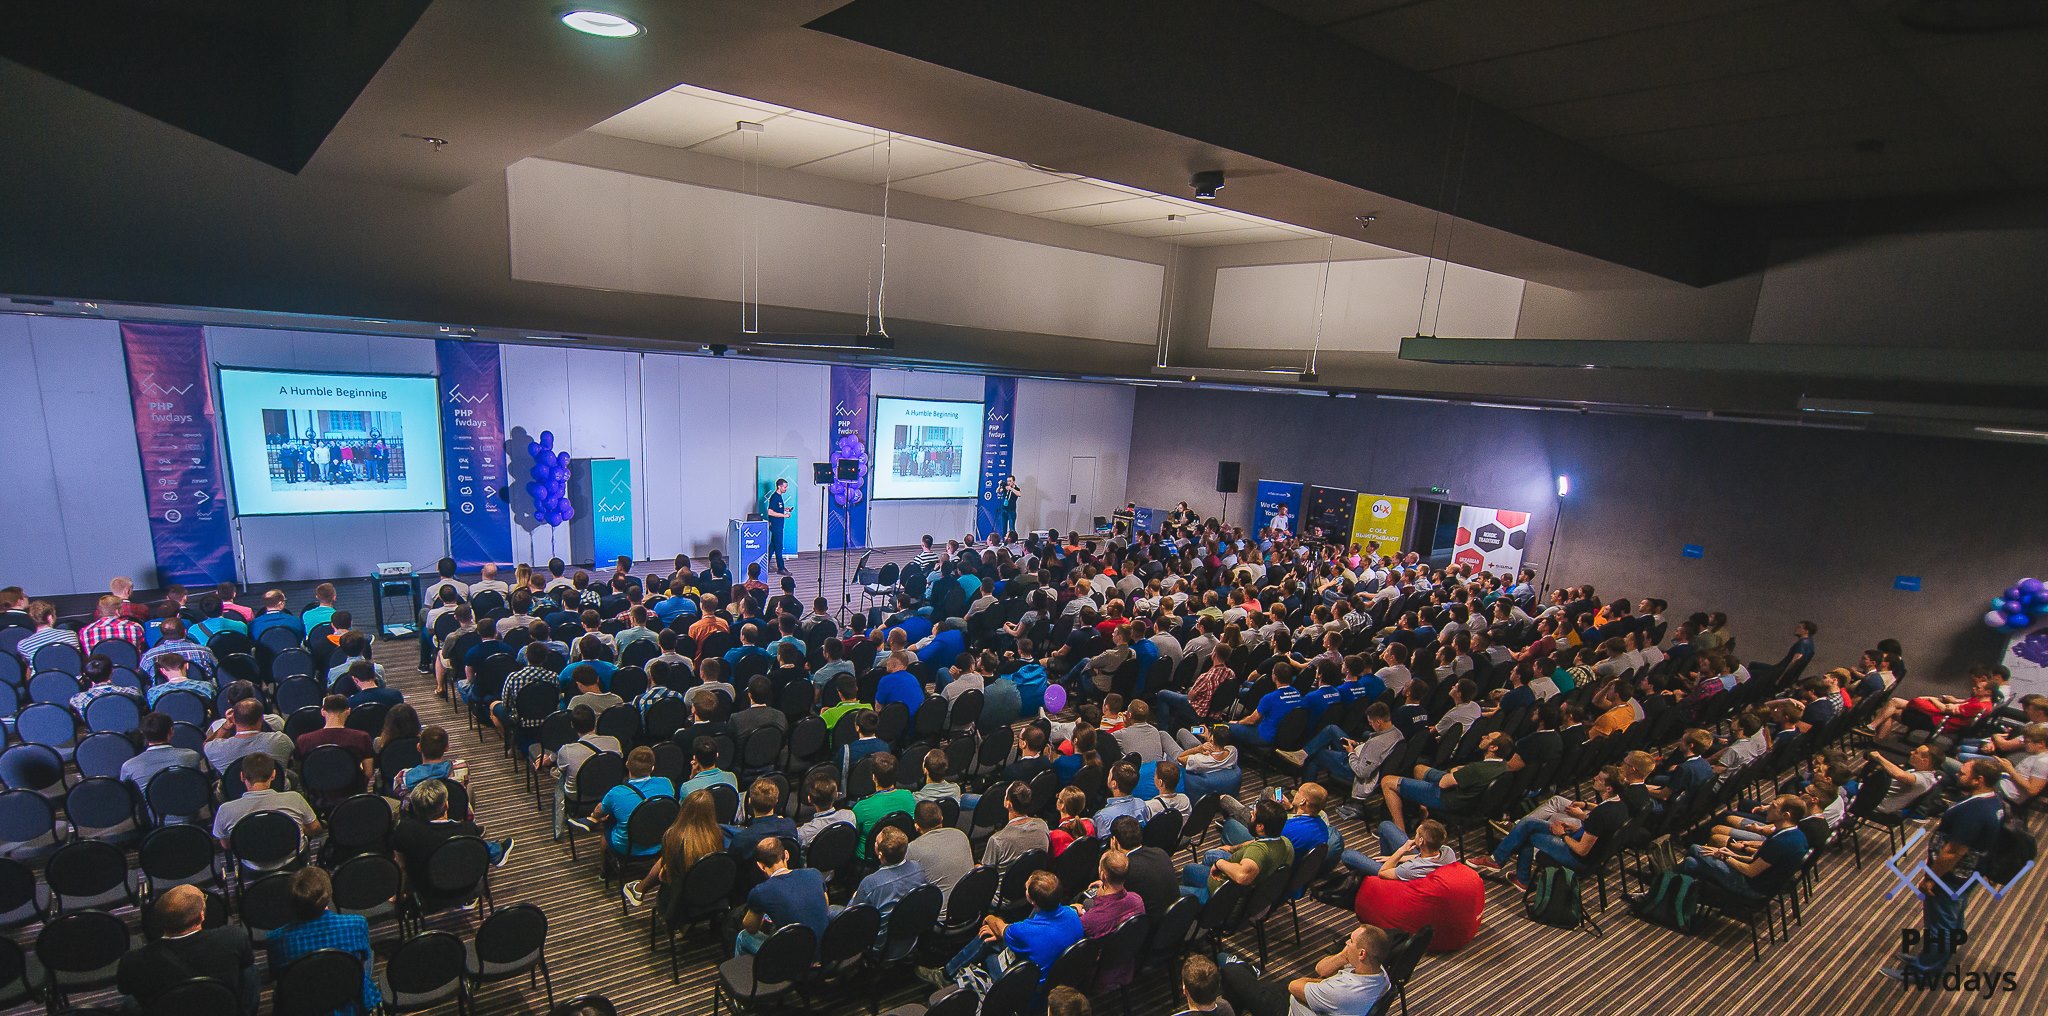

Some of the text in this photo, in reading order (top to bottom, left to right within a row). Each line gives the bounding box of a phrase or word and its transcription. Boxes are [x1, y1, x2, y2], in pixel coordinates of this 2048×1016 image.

[279, 386, 388, 399] A Humble Beginning
[149, 402, 174, 411] PHP
[454, 409, 473, 417] PHP
[933, 411, 959, 419] Beginning
[151, 412, 193, 424] fwdays
[455, 418, 487, 428] fwdays
[1372, 504, 1390, 514] OLX
[601, 515, 625, 523] fwdays
